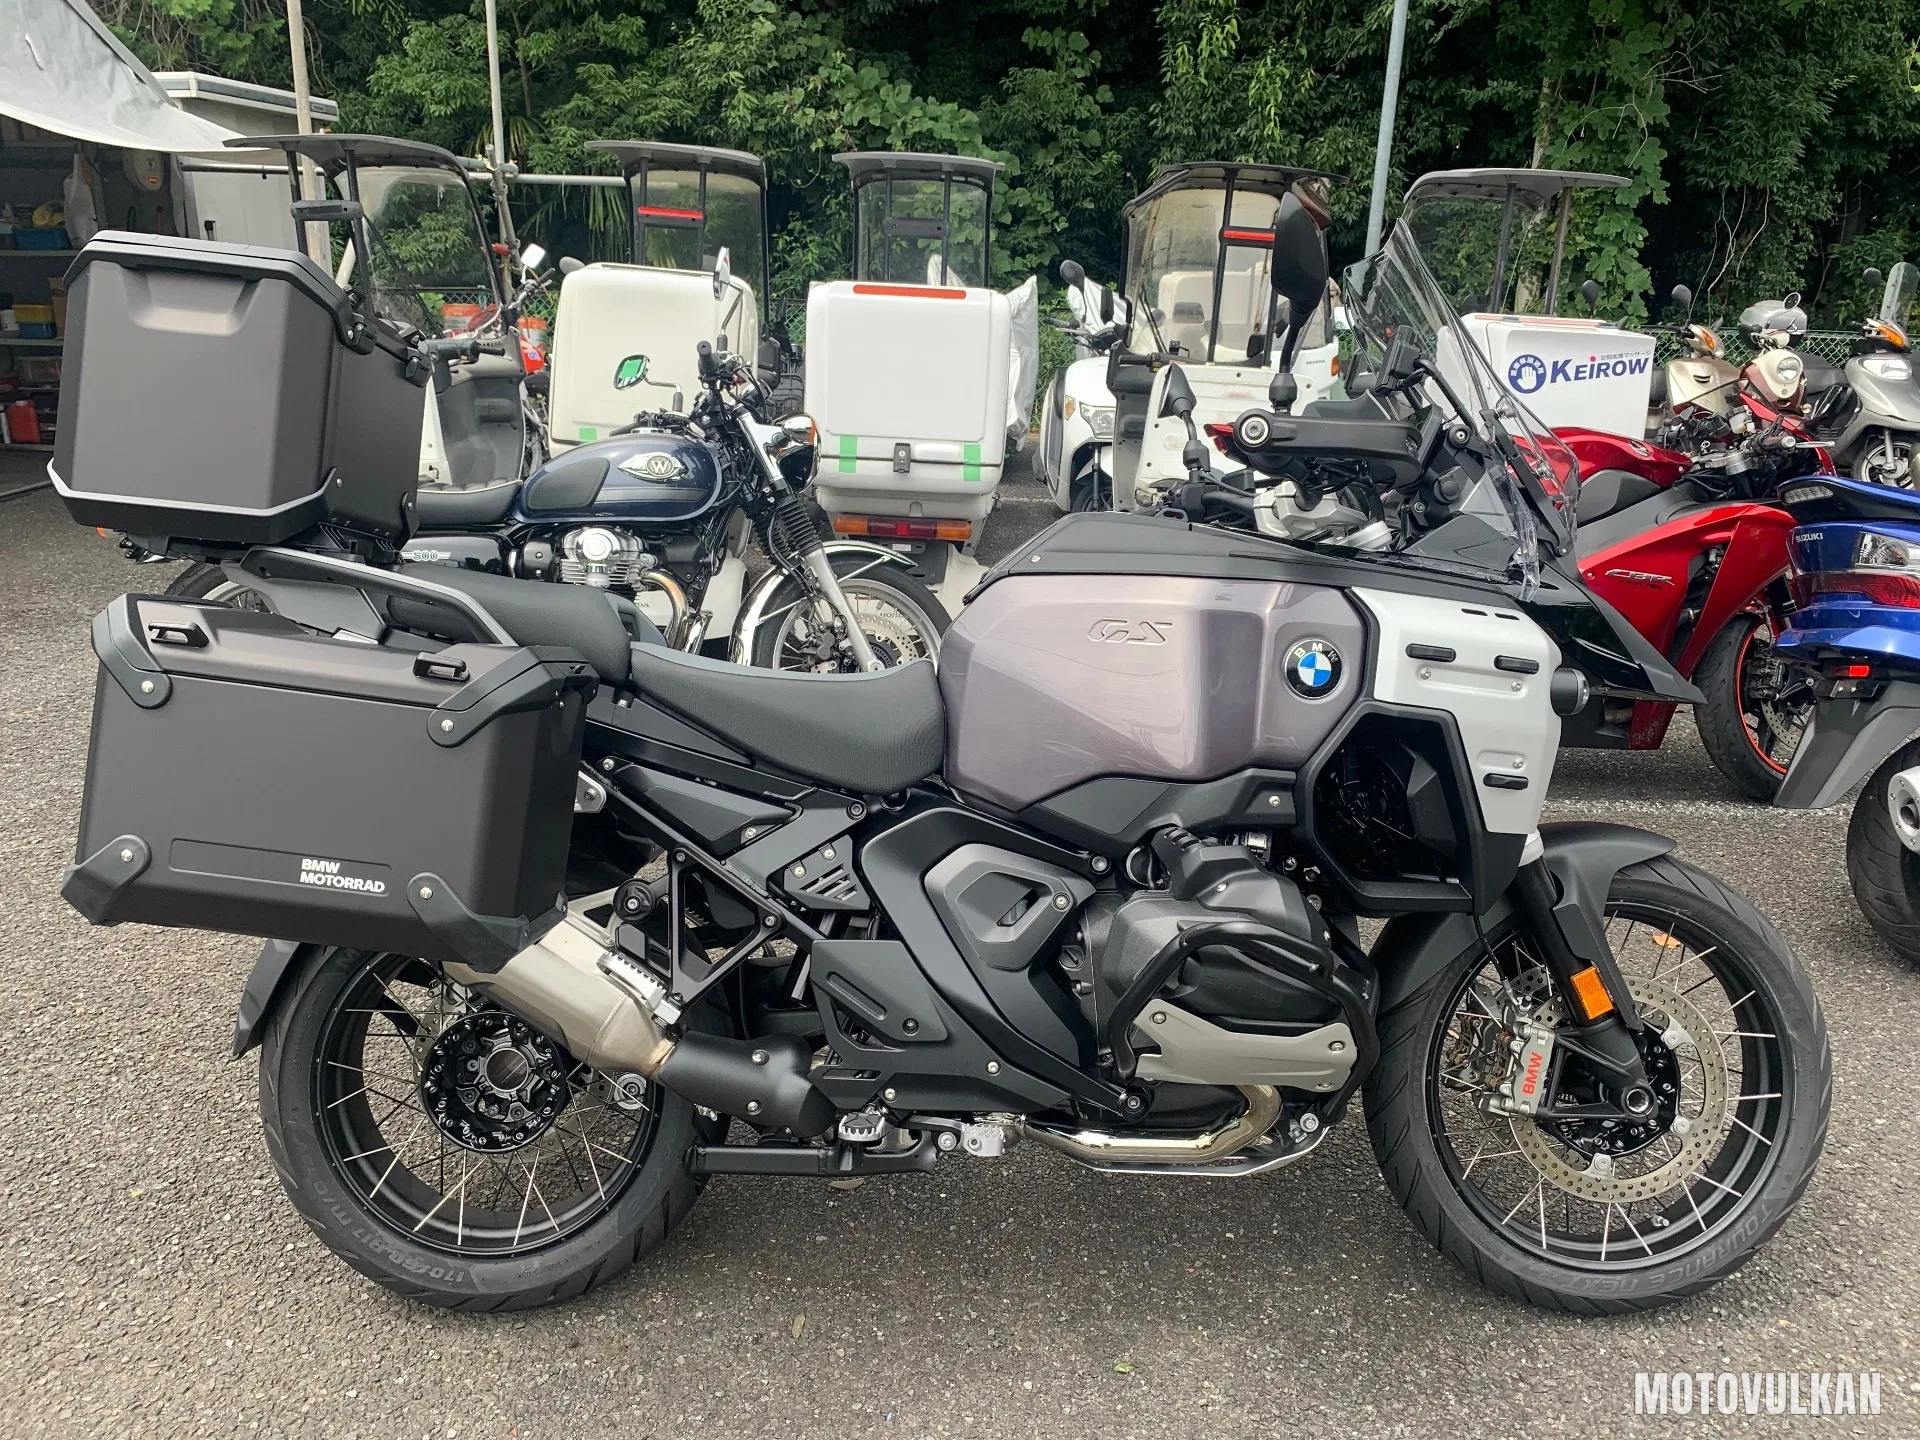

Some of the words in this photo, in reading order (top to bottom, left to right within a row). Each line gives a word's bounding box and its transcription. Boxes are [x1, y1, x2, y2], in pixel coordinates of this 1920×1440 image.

[1600, 350, 1652, 361] 訪問医療マッサージ
[650, 460, 669, 474] W
[1795, 532, 1824, 543] SUZUKI
[1605, 568, 1676, 587] CBR
[1087, 617, 1173, 647] GS
[1294, 642, 1340, 663] BMW
[301, 858, 341, 874] BMW
[299, 871, 386, 893] MOTORRAD
[1521, 1051, 1544, 1095] BMW
[1648, 1202, 1775, 1293] TOURANCE
